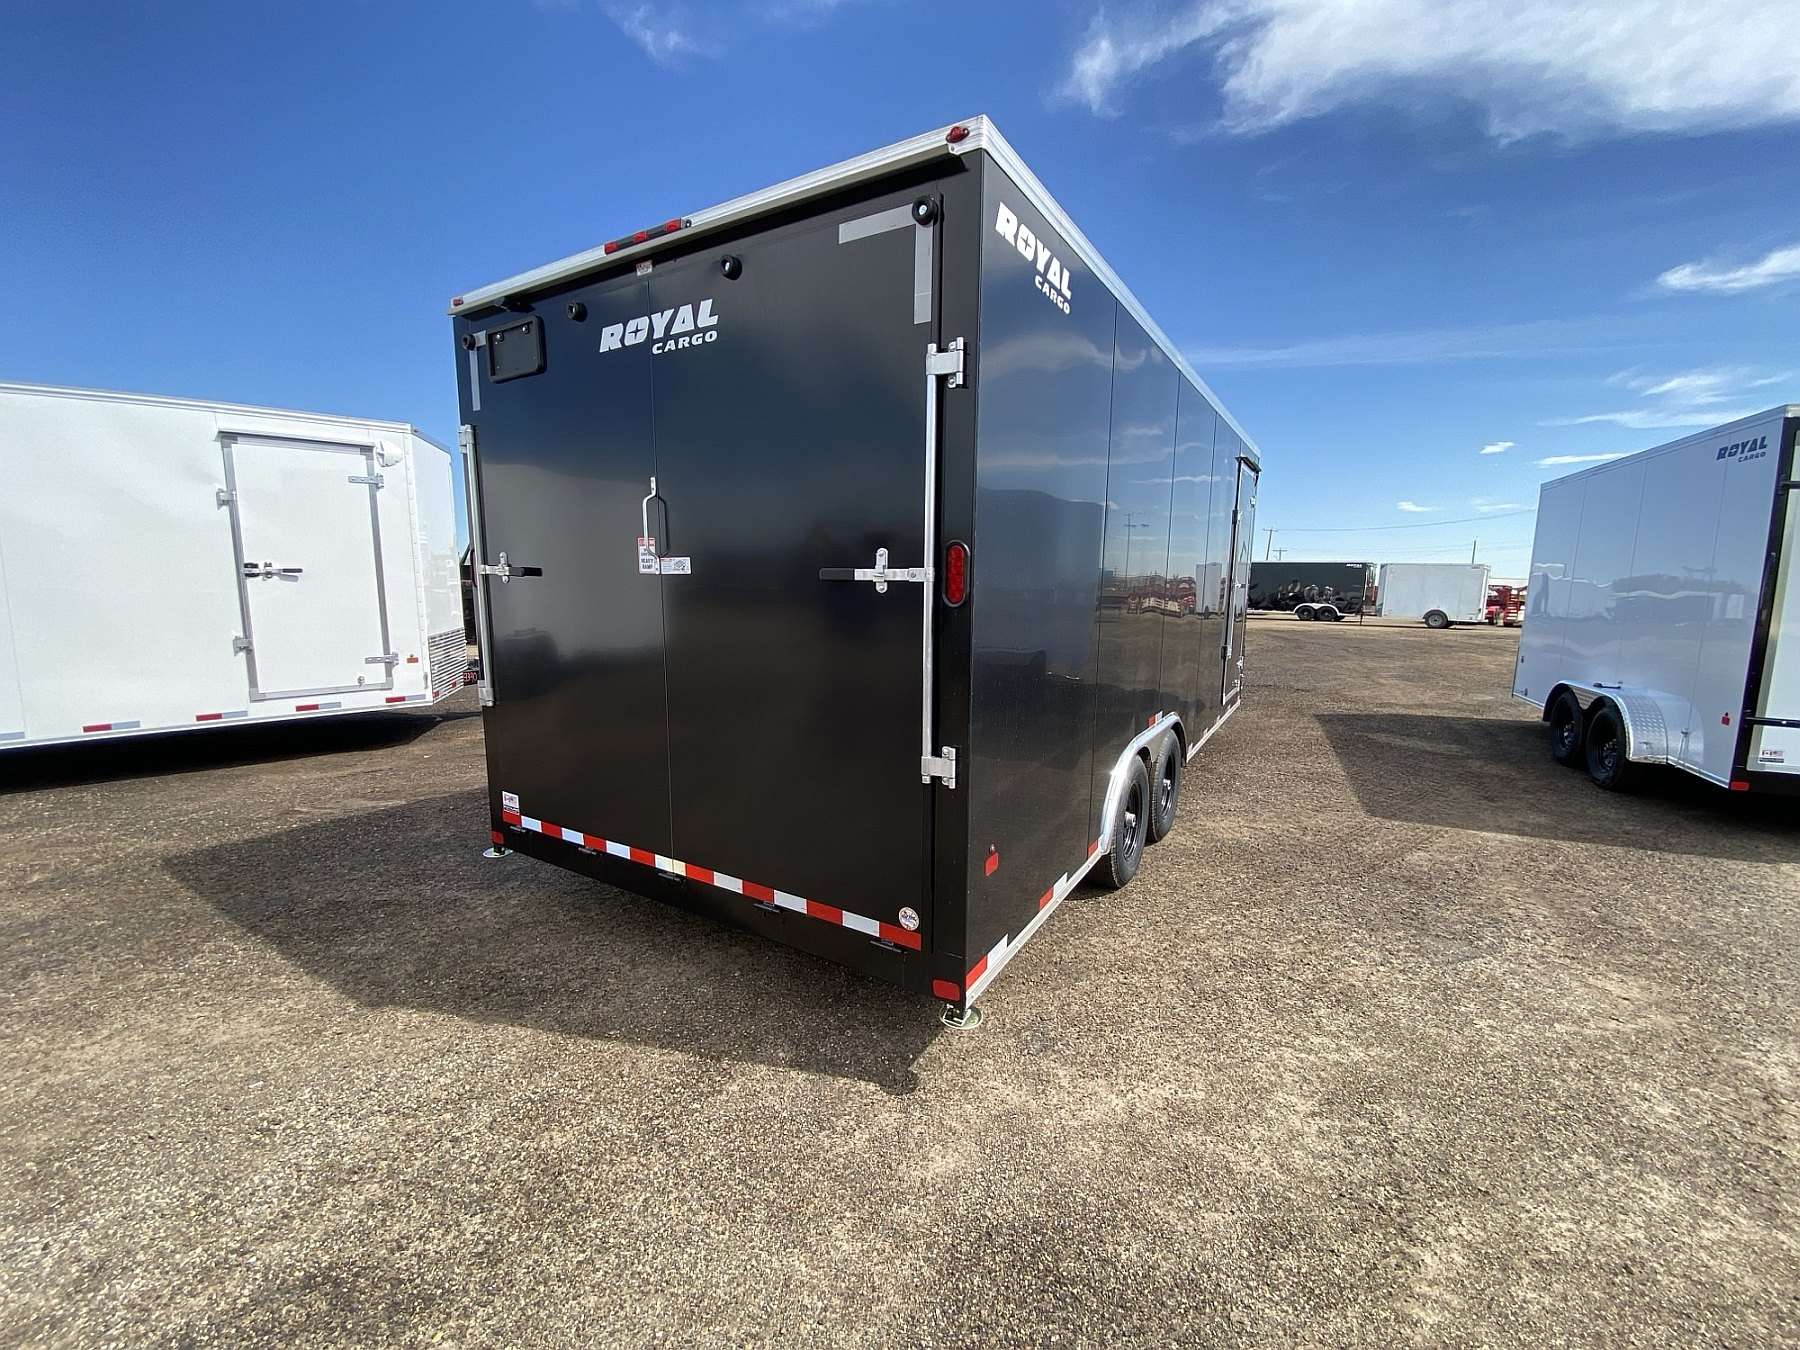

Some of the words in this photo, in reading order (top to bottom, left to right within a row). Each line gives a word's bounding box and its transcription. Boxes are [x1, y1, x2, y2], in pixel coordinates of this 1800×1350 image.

[995, 201, 1072, 300] ROYAL
[1034, 275, 1070, 314] CARGO
[599, 298, 718, 353] ROYAL
[651, 330, 718, 354] CARGO
[1716, 436, 1768, 460] ROYAL
[1738, 451, 1767, 463] CARGO
